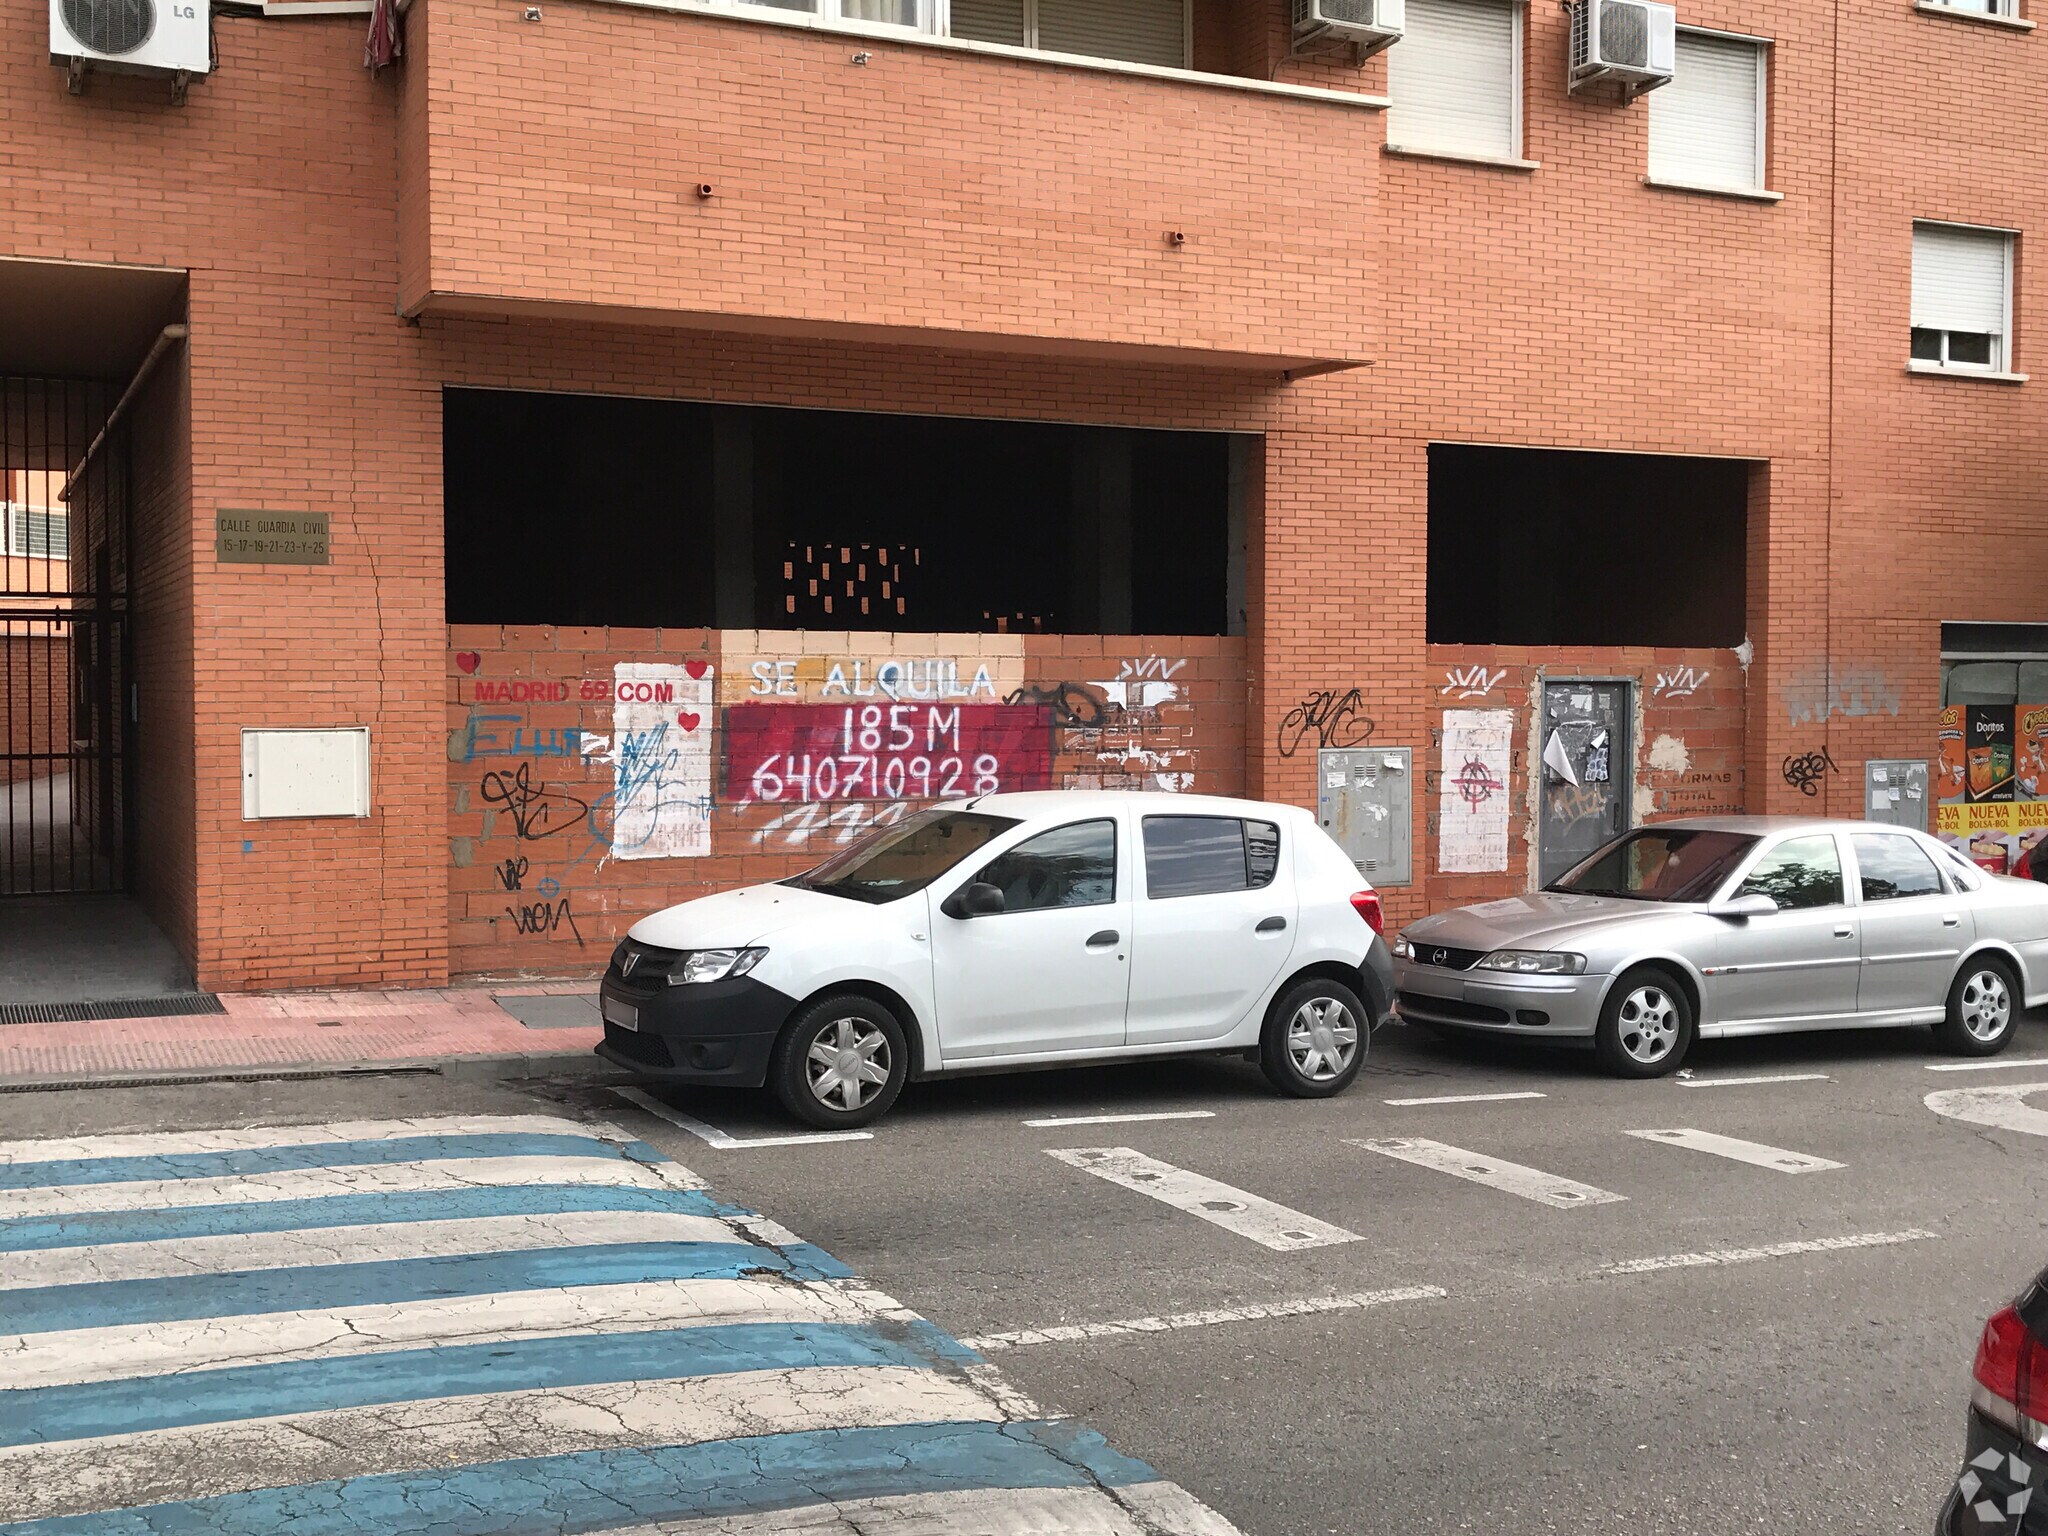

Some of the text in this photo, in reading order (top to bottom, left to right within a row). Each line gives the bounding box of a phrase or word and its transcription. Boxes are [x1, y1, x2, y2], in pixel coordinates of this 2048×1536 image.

[173, 5, 195, 19] LG
[220, 518, 326, 535] CALLE GUARDIA CIVIL
[750, 660, 996, 701] SE ALQUILA
[475, 681, 673, 703] MADRID 69 COM
[1976, 722, 2005, 732] Doritos
[752, 754, 999, 802] 640710928
[1969, 804, 2010, 819] NUEVA
[1968, 819, 2010, 828] BOLSA-BOL
